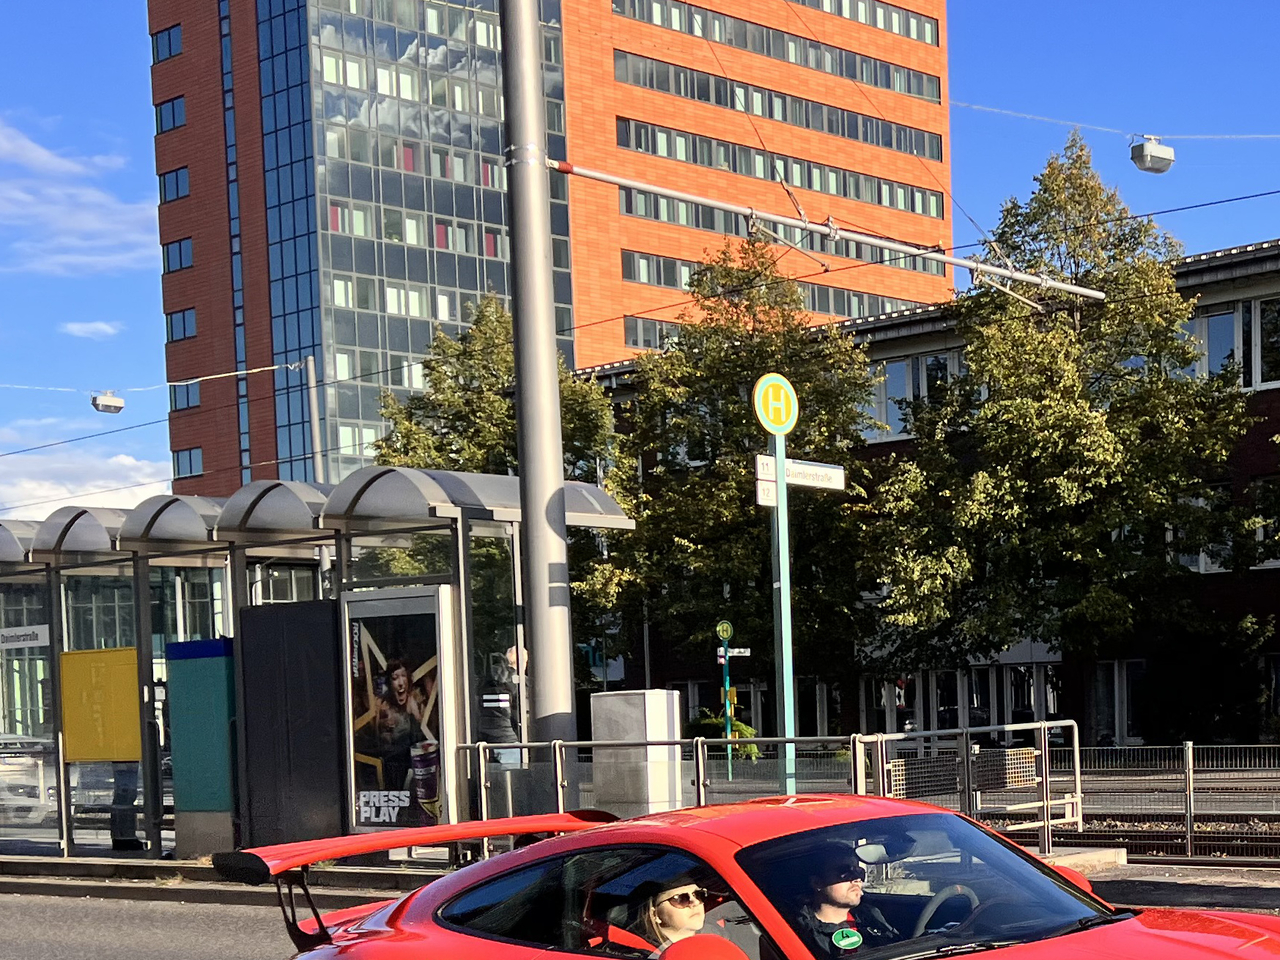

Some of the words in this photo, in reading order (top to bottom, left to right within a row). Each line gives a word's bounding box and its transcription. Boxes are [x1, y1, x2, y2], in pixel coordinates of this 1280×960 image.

[768, 387, 786, 422] H
[761, 462, 769, 472] 11
[785, 468, 833, 483] Daimlerstraße
[762, 488, 770, 497] 12
[1, 631, 39, 643] Daimlerstraße
[360, 791, 410, 807] PRESS
[360, 806, 399, 822] PLAY
